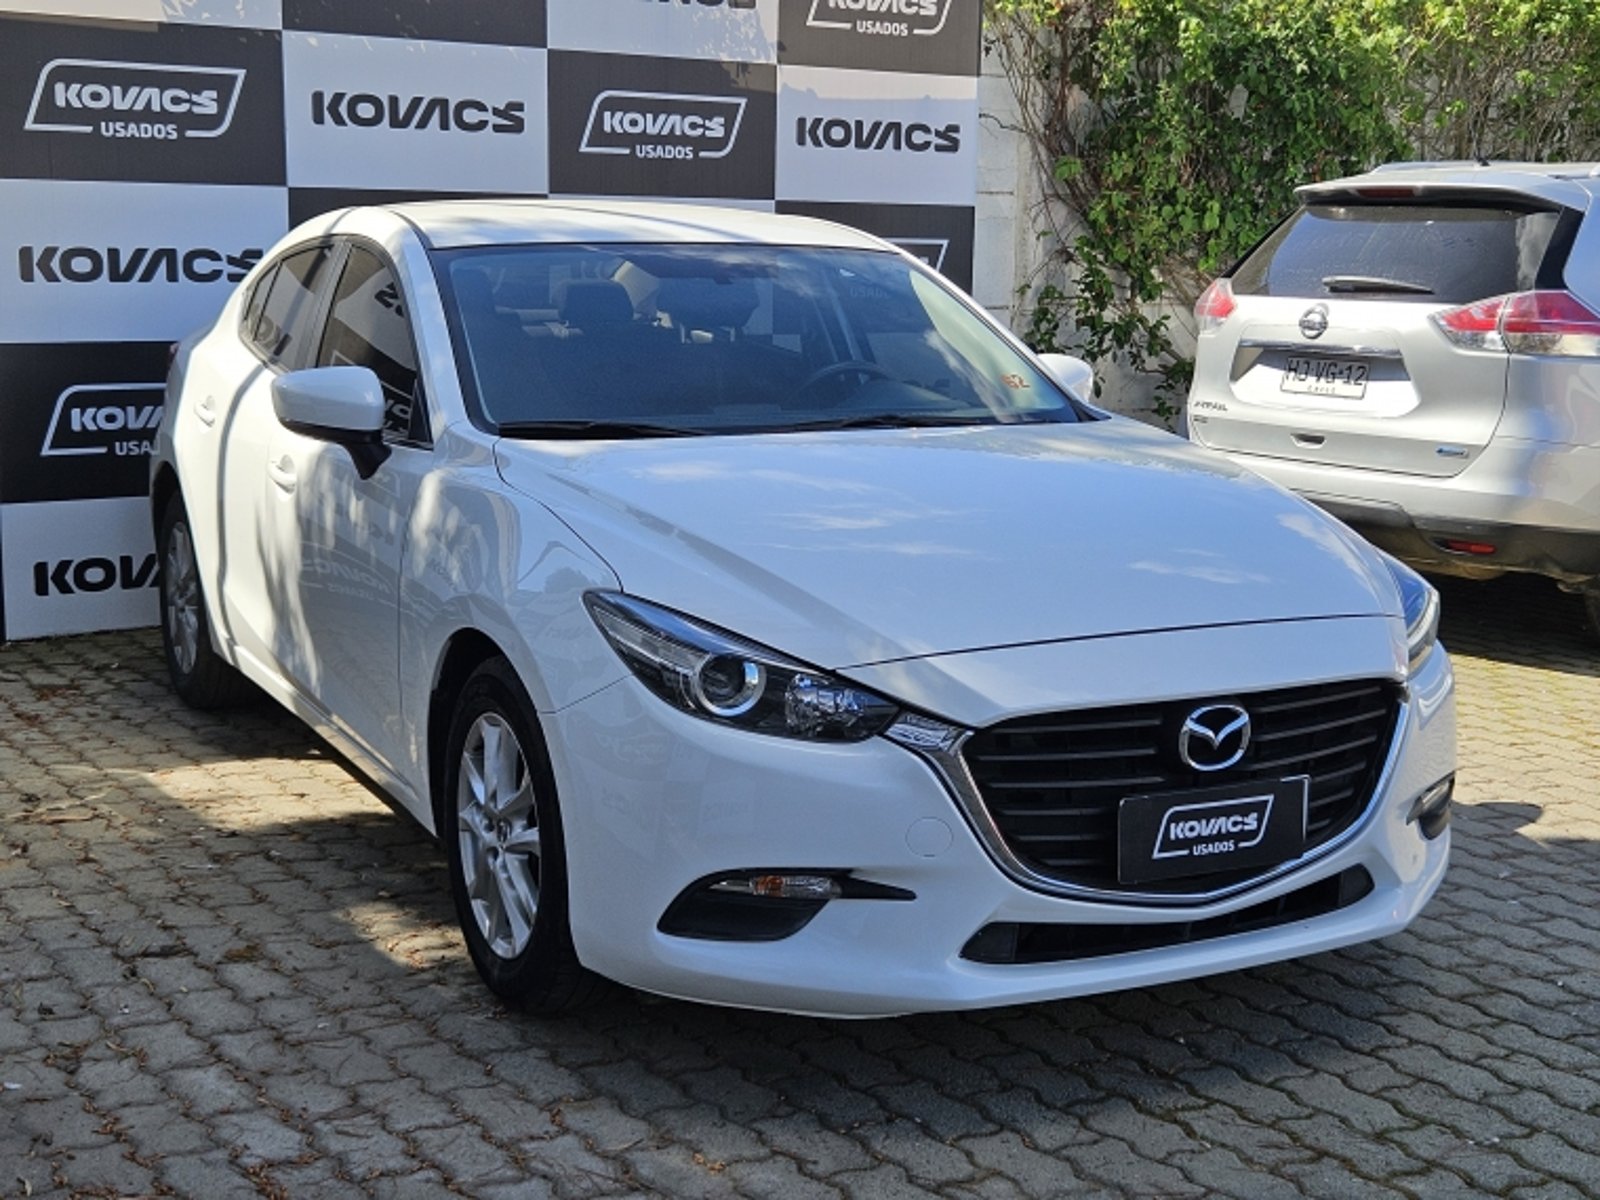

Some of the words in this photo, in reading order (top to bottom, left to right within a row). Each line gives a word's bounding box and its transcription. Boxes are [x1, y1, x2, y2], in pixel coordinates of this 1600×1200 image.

[856, 19, 909, 37] USADOS
[54, 81, 218, 115] KOVACS
[312, 89, 525, 134] KOVACS
[100, 121, 178, 140] USADOS
[603, 110, 726, 138] KOVACS
[796, 116, 961, 153] KOVACS
[635, 144, 694, 160] USADOS
[18, 246, 264, 283] KOVACS
[71, 405, 164, 432] KOVA
[114, 441, 153, 456] USA
[1169, 812, 1258, 841] KOVACS
[1192, 840, 1235, 856] USADOS
